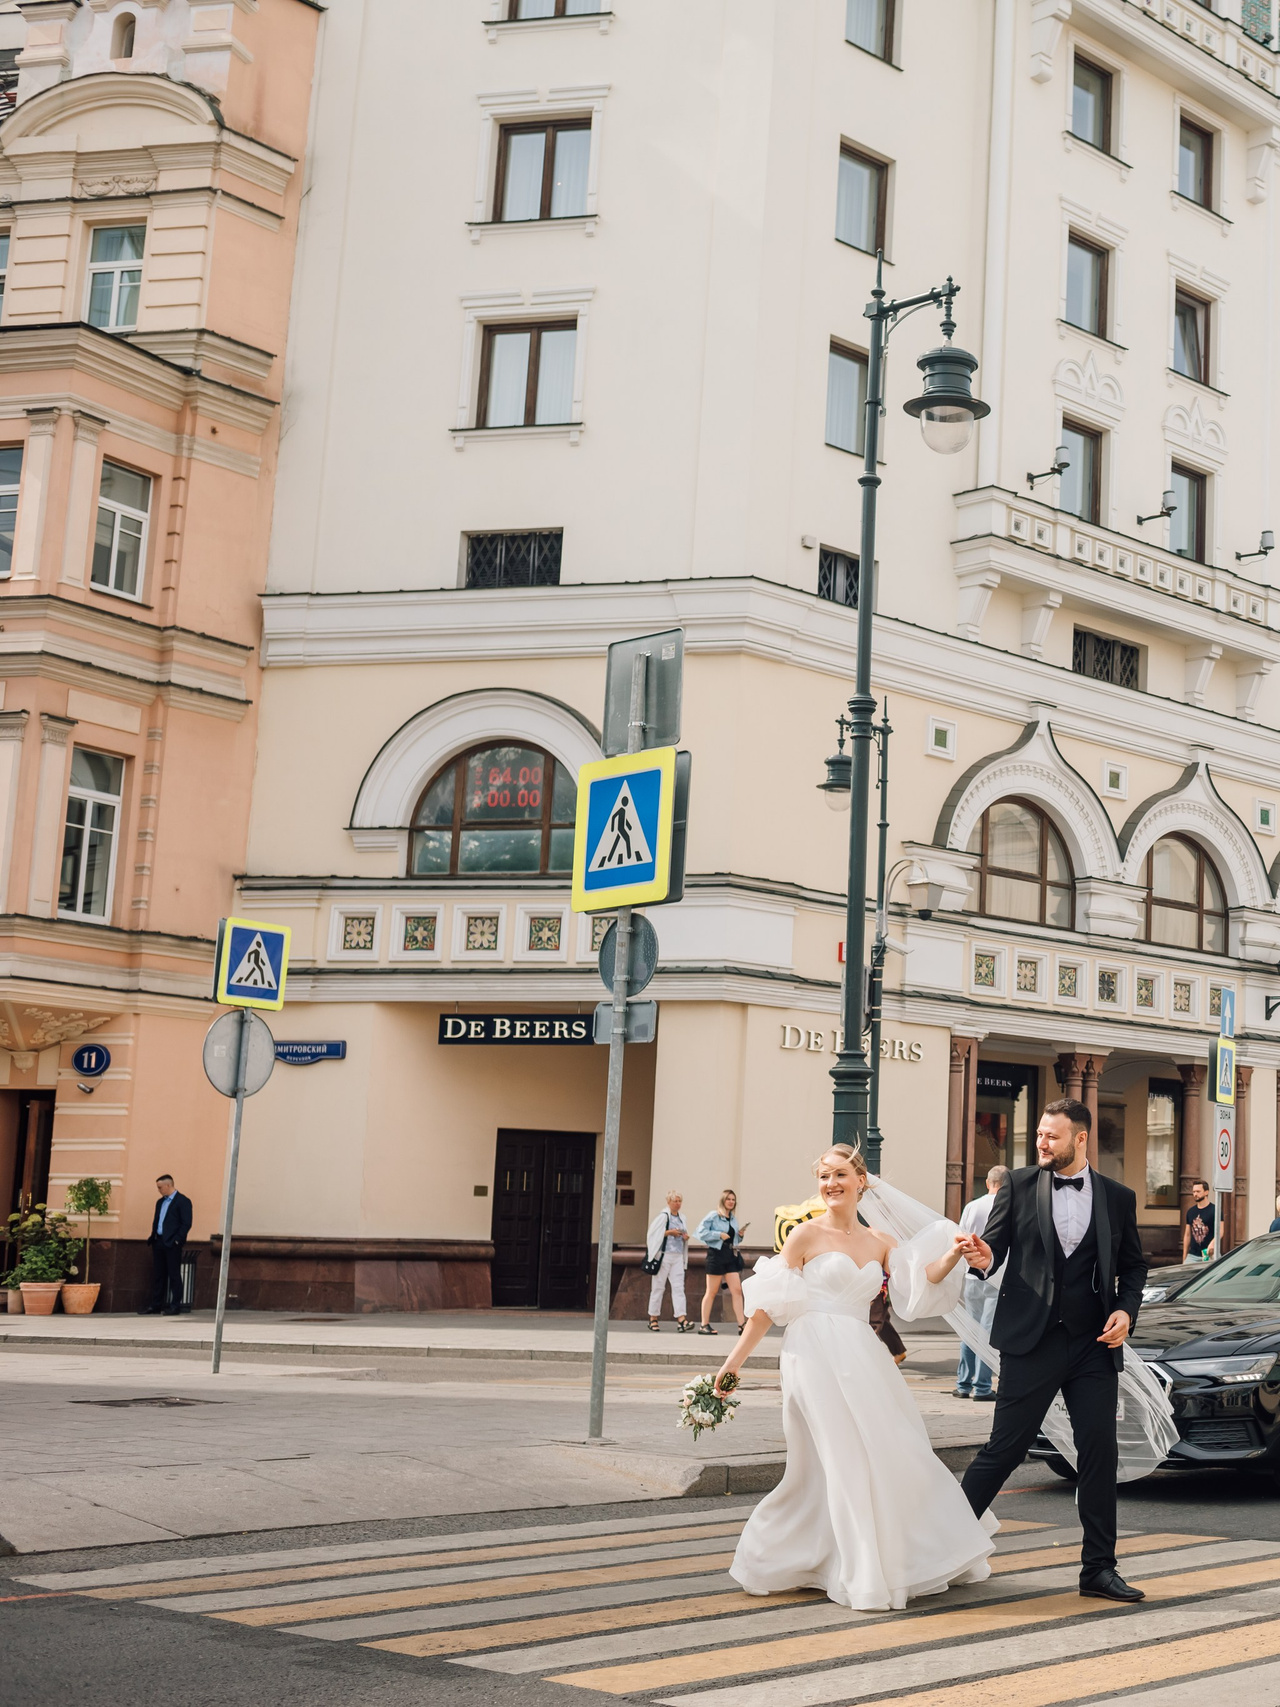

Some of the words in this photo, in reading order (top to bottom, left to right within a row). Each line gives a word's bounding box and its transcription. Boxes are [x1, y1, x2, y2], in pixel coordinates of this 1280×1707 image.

[489, 767, 542, 785] 64.00
[487, 790, 540, 807] 00.00
[443, 1018, 485, 1039] DE
[492, 1018, 587, 1039] BEERS
[780, 1024, 825, 1052] DE
[82, 1051, 97, 1069] 11
[984, 1077, 1012, 1087] BEERS
[1219, 1110, 1231, 1120] ЗОНА
[1220, 1141, 1229, 1158] 30
